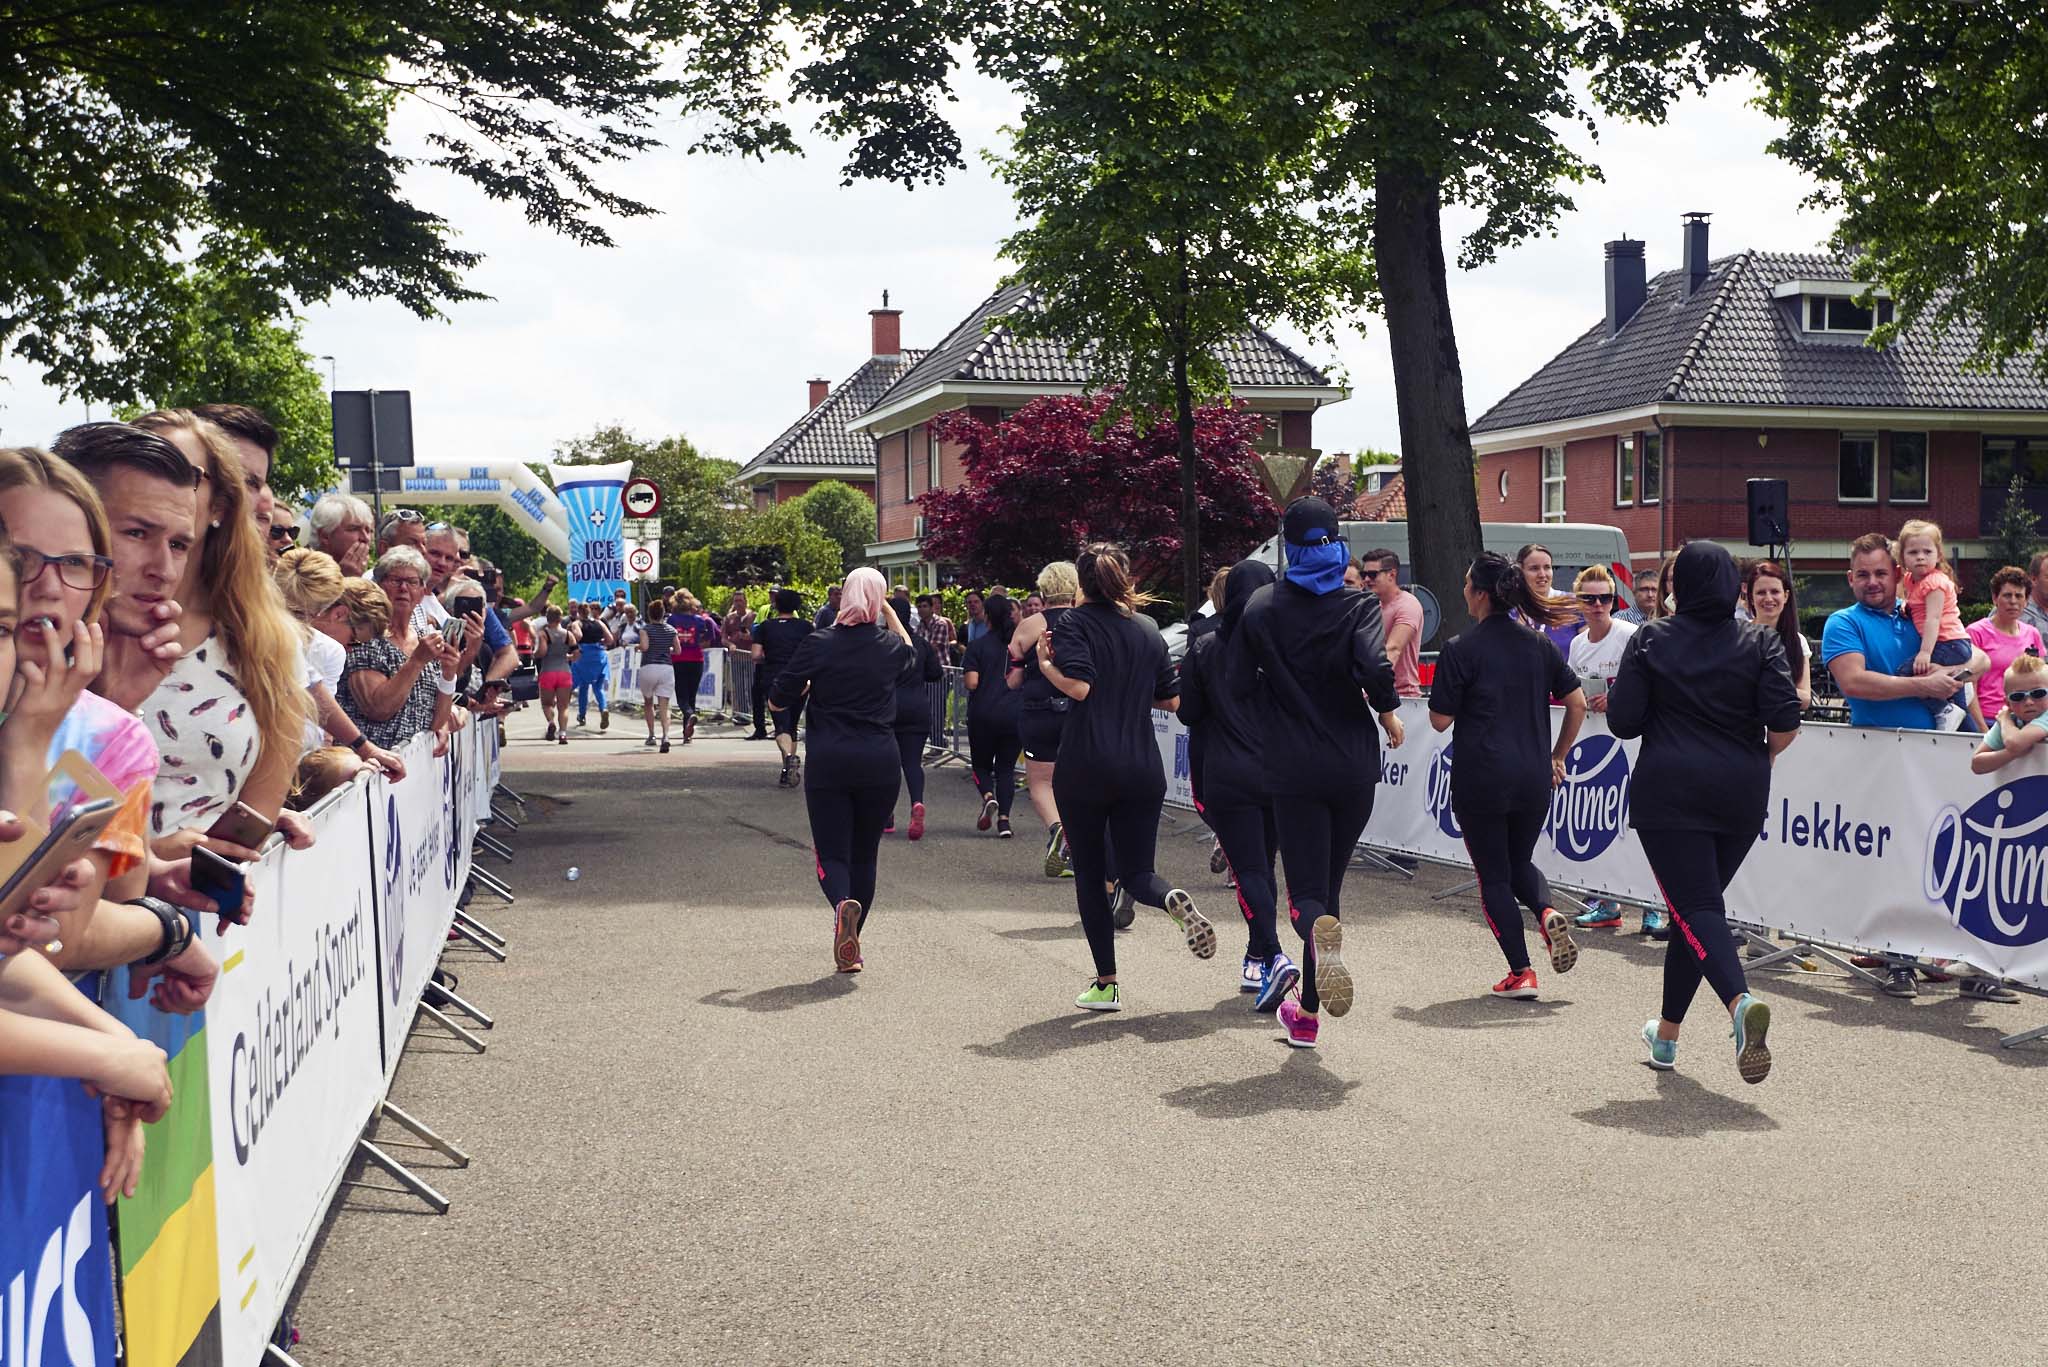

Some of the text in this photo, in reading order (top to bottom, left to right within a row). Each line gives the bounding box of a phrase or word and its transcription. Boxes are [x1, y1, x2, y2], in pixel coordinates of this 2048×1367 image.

[416, 467, 435, 479] ICE
[470, 467, 489, 479] ICE
[405, 479, 447, 491] POWER
[459, 479, 501, 491] POWER
[511, 488, 546, 523] POWER
[585, 540, 615, 561] ICE
[634, 556, 649, 565] 30
[571, 561, 624, 582] POWE
[1781, 798, 1891, 858] lekker
[231, 888, 365, 1166] Gelderland Sport!
